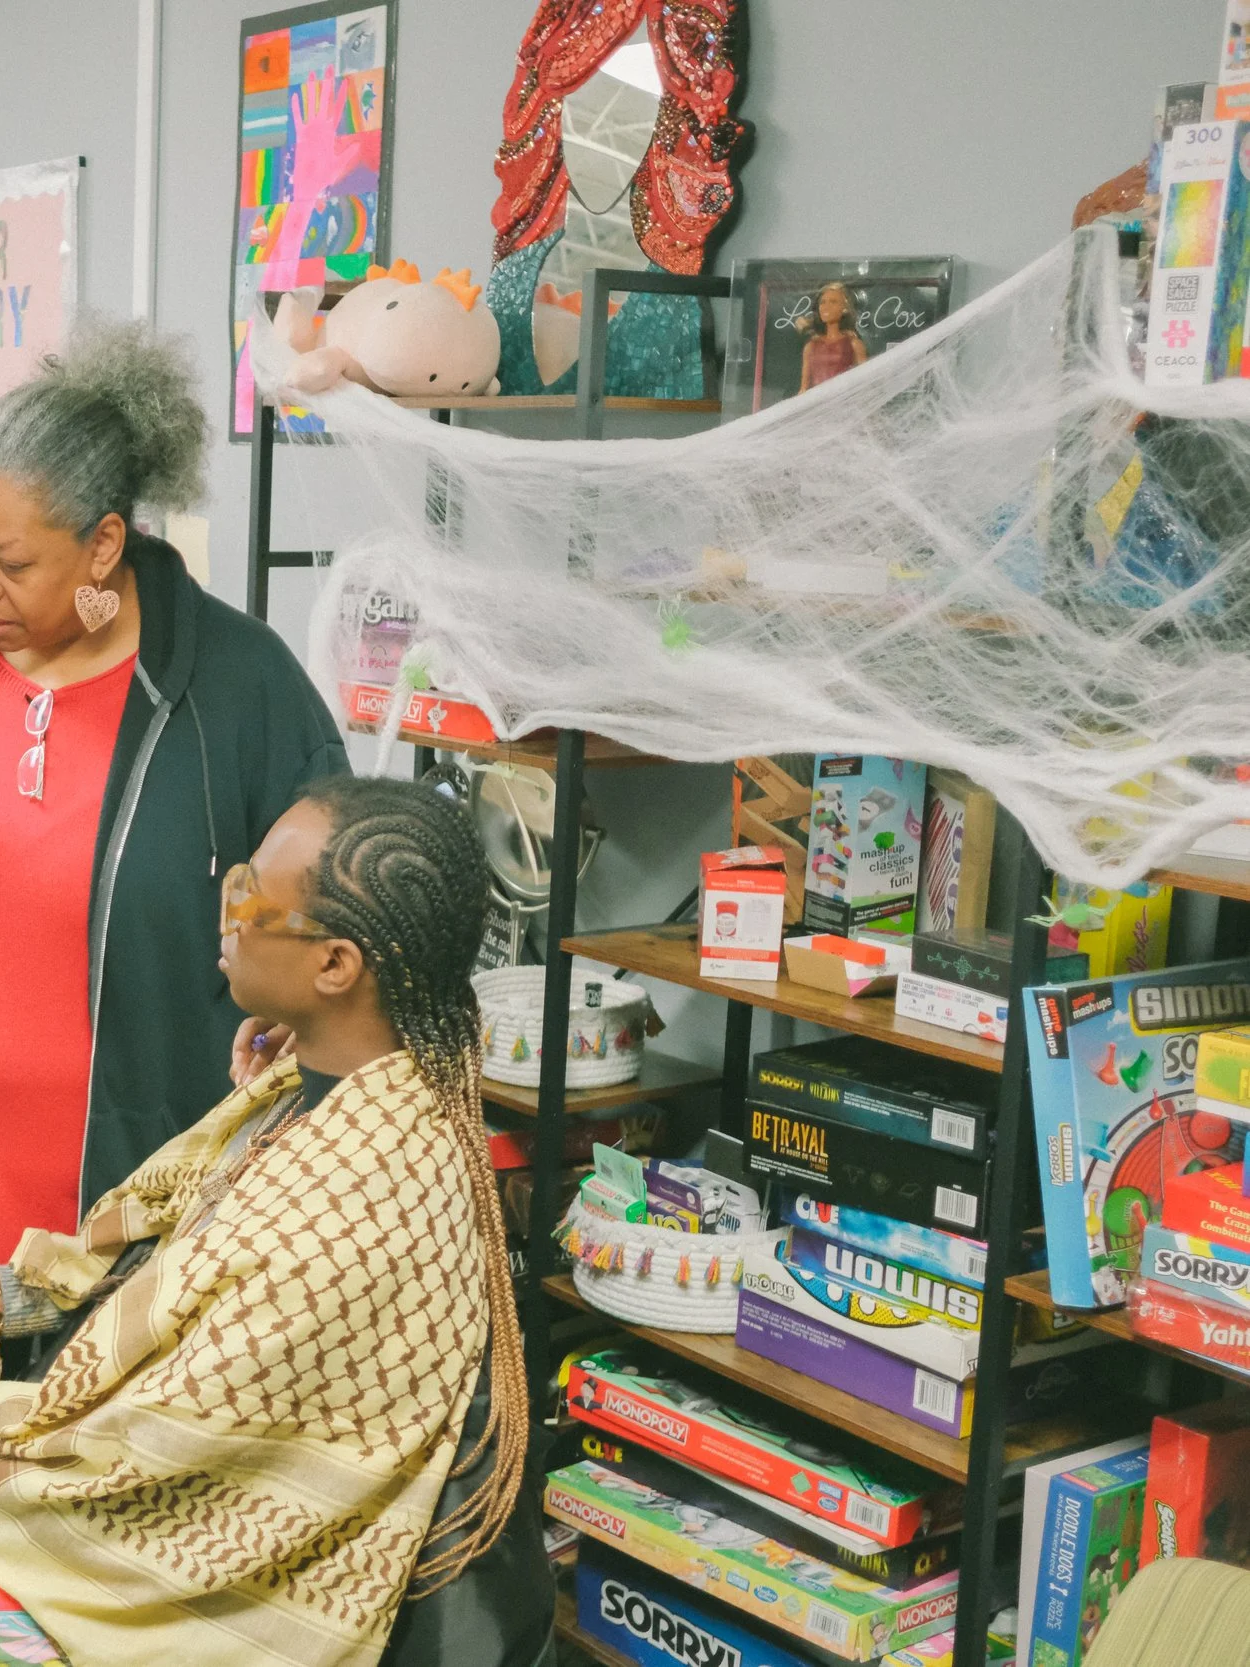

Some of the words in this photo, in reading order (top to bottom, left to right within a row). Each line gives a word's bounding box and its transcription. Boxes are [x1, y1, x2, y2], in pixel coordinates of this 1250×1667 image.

[1185, 127, 1222, 145] 300
[1167, 276, 1198, 289] SPACE
[1167, 287, 1198, 300] SAVER
[874, 296, 925, 329] Cox
[1165, 301, 1196, 313] PUZZLE
[869, 854, 915, 873] classics
[890, 872, 913, 889] fun!
[1046, 998, 1062, 1033] game
[752, 1110, 829, 1159] BETRAYAL
[795, 1193, 839, 1226] CLUE
[1209, 1200, 1228, 1214] The
[720, 1213, 741, 1232] SHIP
[745, 1272, 796, 1301] TROUBLE
[607, 1395, 686, 1440] MONOPOLY
[582, 1434, 623, 1463] CLUE
[550, 1491, 625, 1536] MONOPOLY
[1060, 1497, 1082, 1550] DOODLE
[1056, 1548, 1074, 1584] DOGS
[1046, 1597, 1056, 1630] PUZZLE
